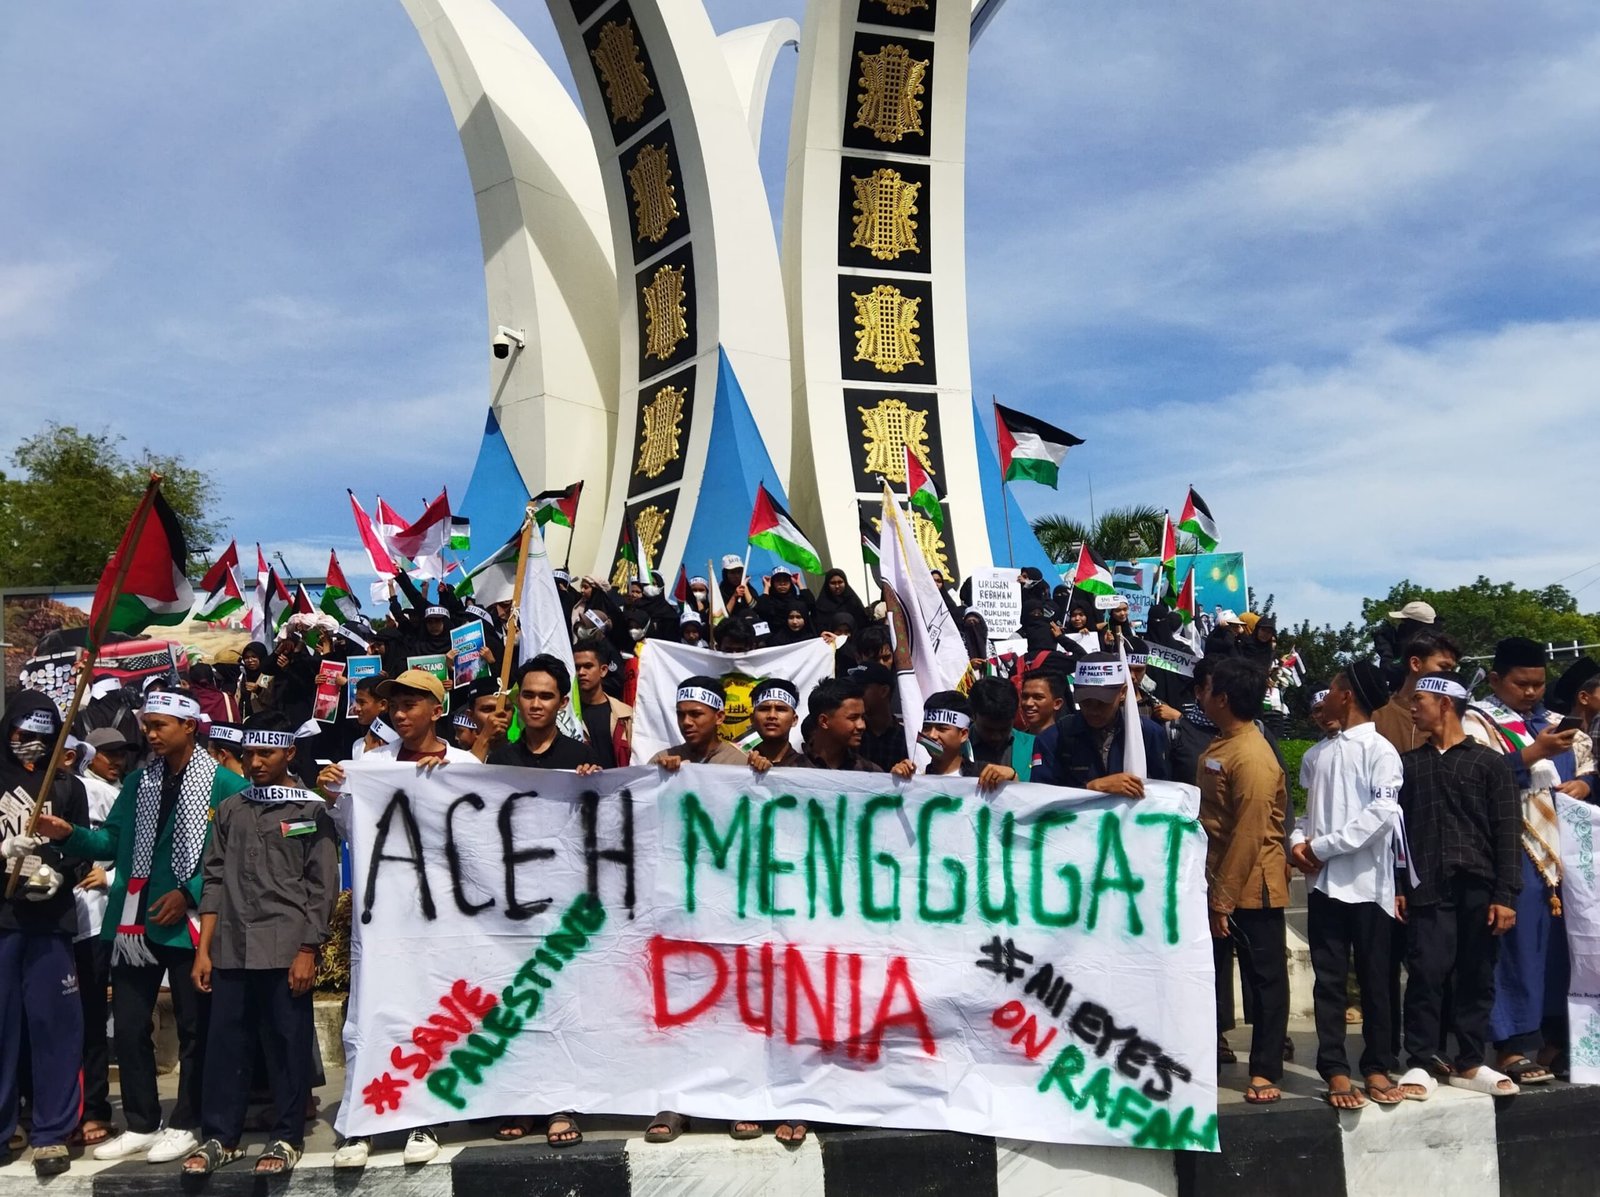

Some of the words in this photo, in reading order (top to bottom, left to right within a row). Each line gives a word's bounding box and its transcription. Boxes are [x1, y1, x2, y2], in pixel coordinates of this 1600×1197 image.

[978, 581, 1009, 589] URUSAN
[979, 590, 1012, 599] REBAHAN
[423, 662, 444, 671] STAND
[679, 689, 722, 710] PALSTINE
[254, 787, 308, 800] PALESTINE
[361, 788, 635, 924] ACEH
[680, 790, 1200, 946] MENGGUGAT
[650, 934, 937, 1064] DUNIA
[991, 999, 1058, 1060] ON
[1068, 1000, 1192, 1102] EYES
[1036, 1044, 1219, 1152] RAFAH
